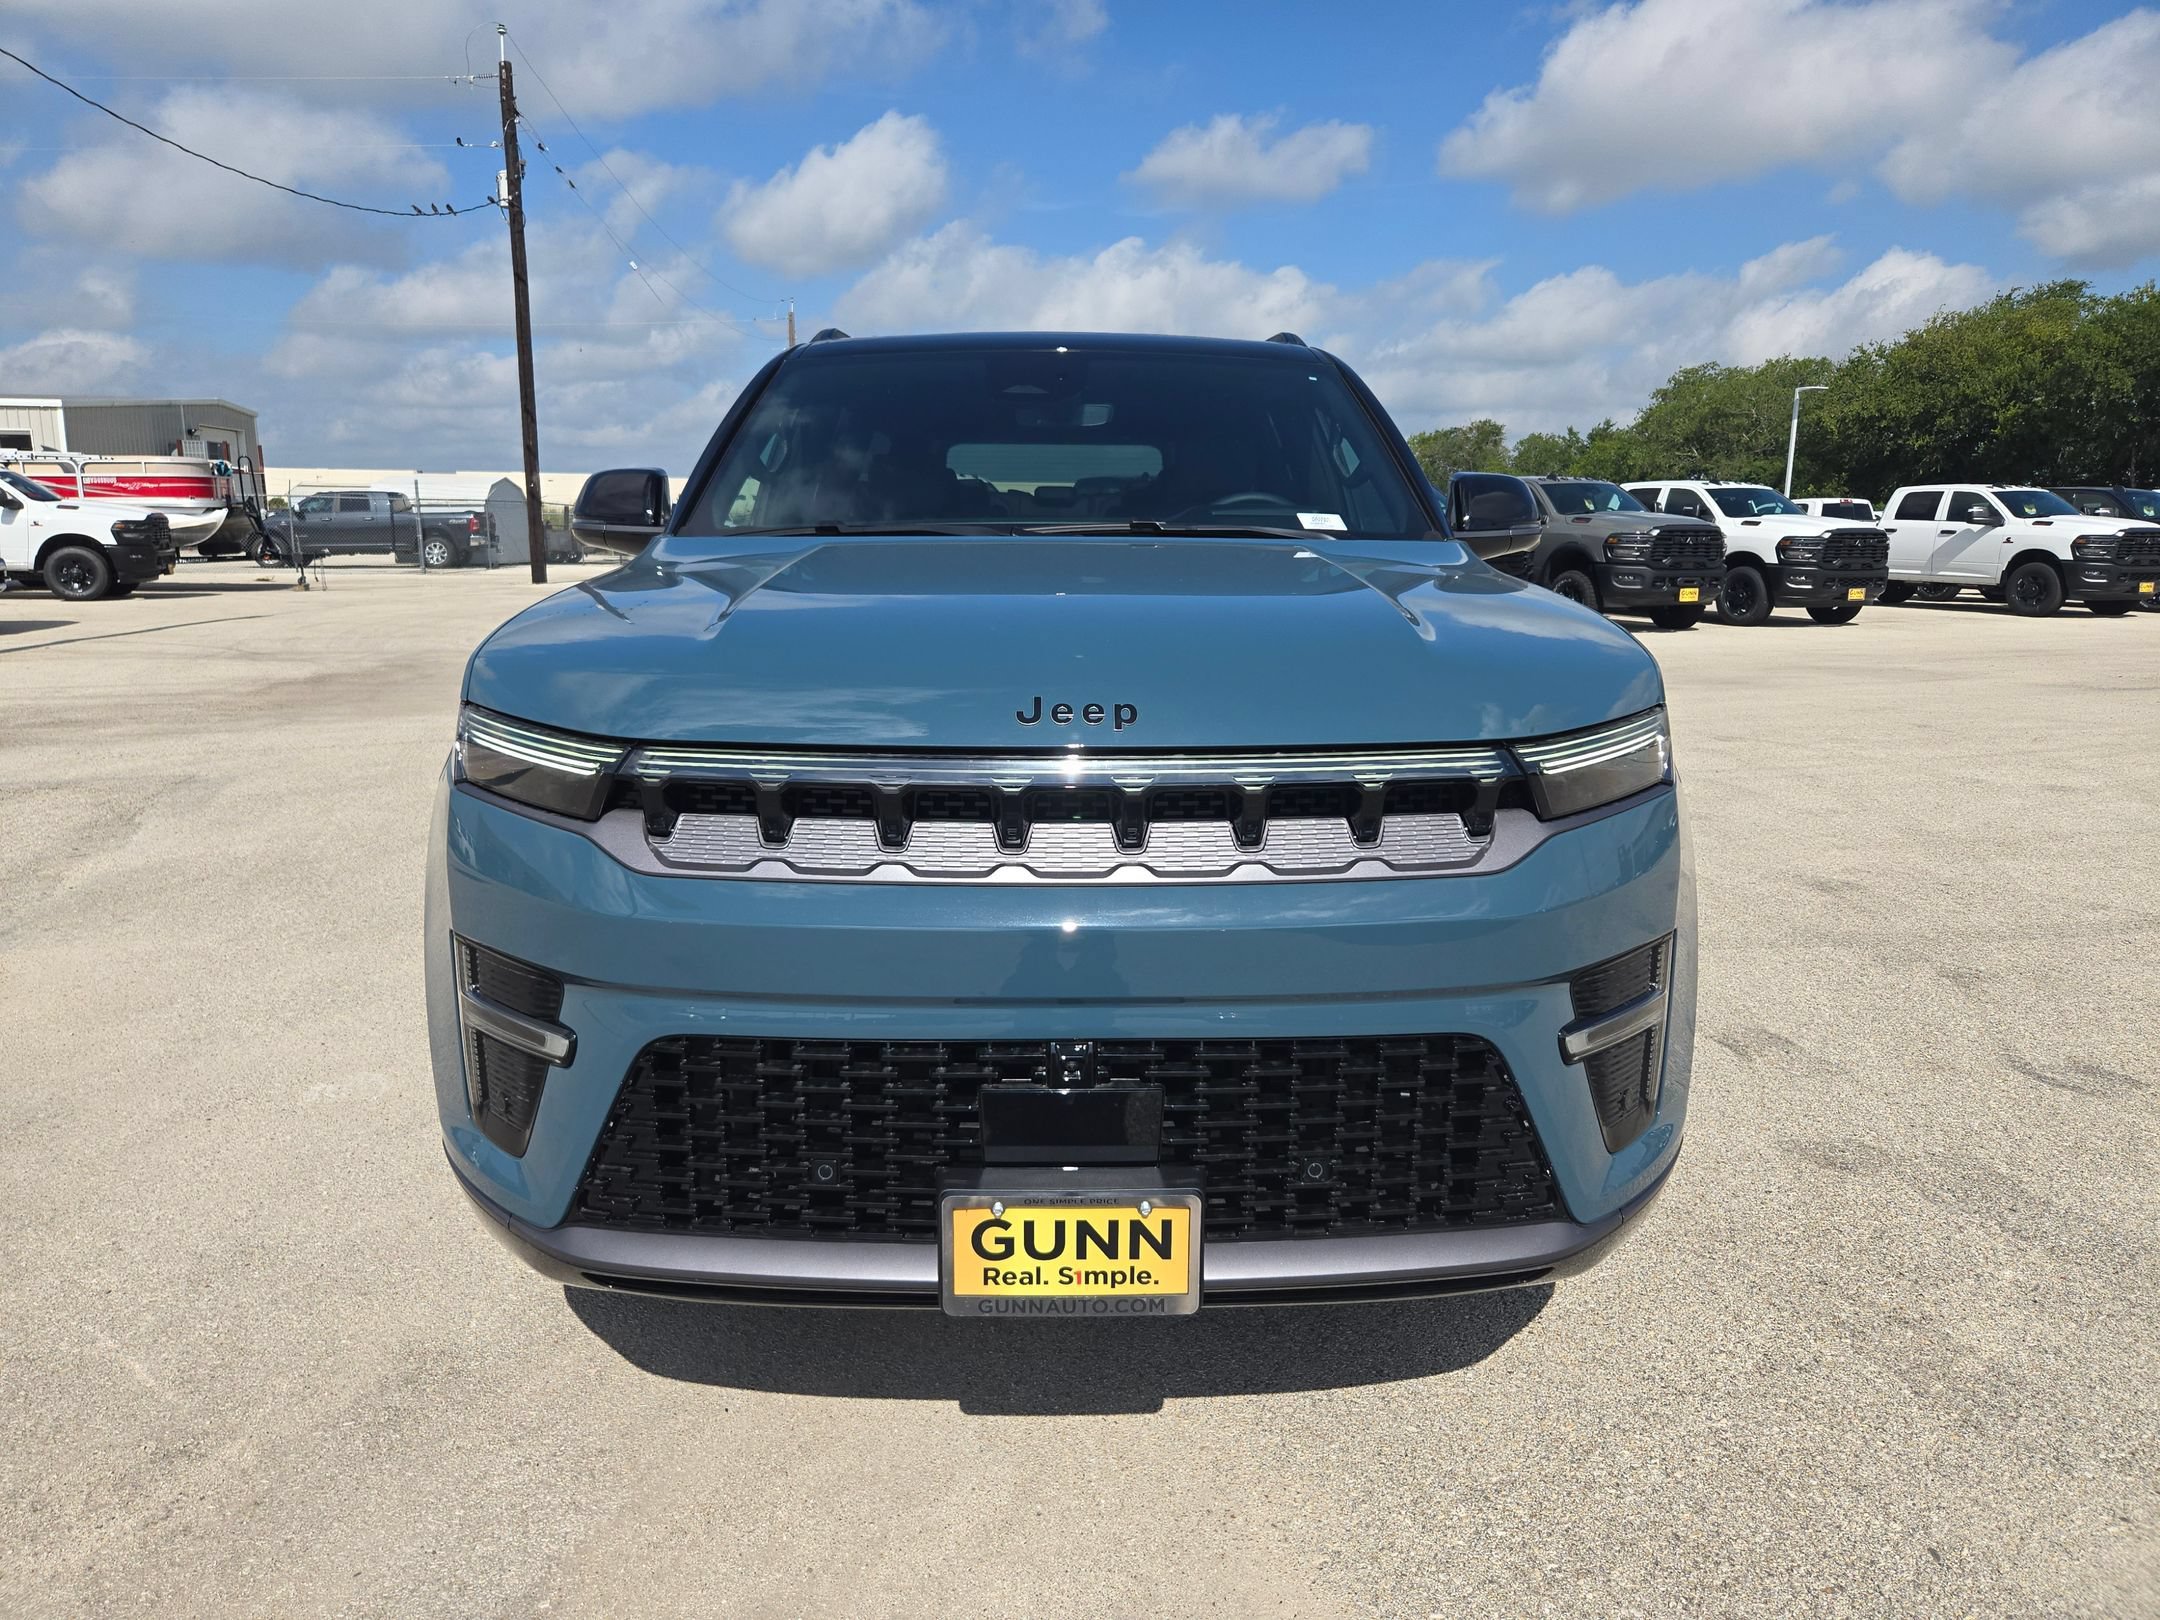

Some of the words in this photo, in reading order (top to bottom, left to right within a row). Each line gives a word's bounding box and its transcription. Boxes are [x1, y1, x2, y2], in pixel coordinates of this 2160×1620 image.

[1015, 695, 1138, 732] Jeep
[970, 1218, 1173, 1262] GUNN
[983, 1266, 1049, 1286] Real.
[977, 1297, 1165, 1315] GUNNAUTO.COM
